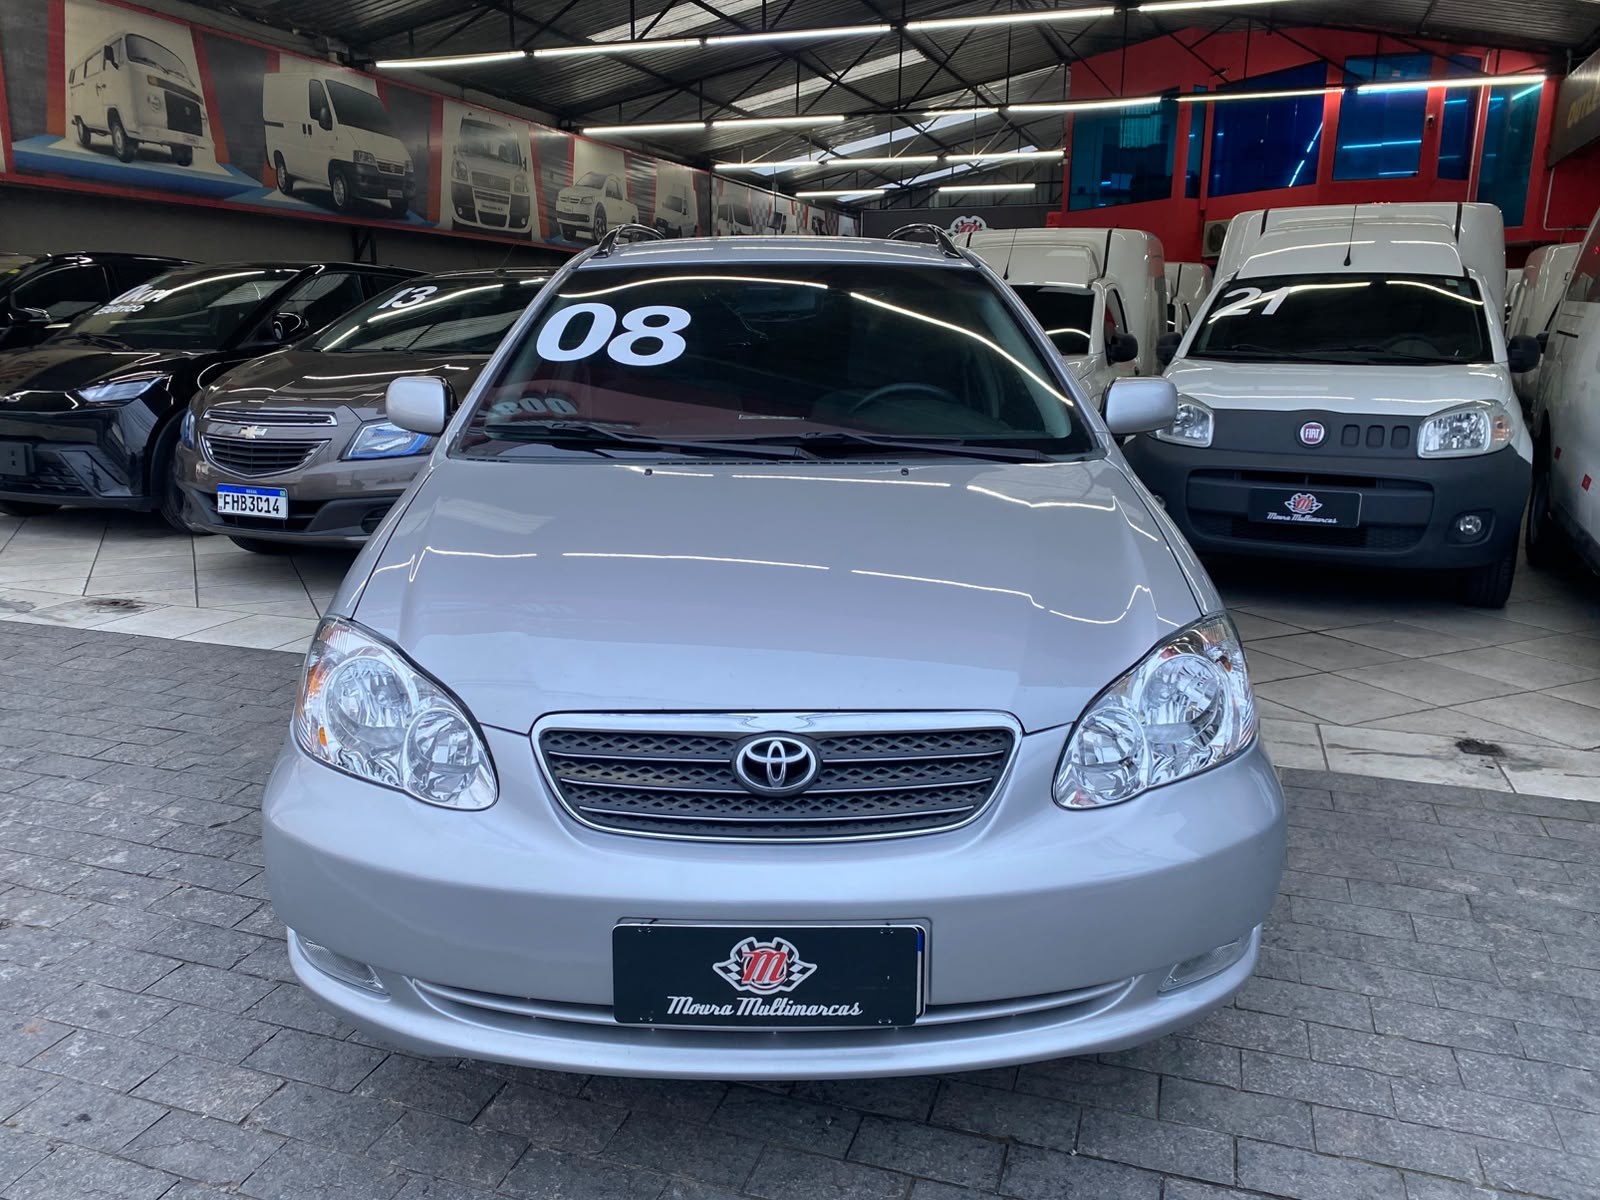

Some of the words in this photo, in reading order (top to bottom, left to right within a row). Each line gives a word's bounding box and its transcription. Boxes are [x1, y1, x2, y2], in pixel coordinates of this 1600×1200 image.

[377, 286, 438, 309] 13
[1209, 287, 1292, 316] 21
[536, 303, 692, 366] 08
[1305, 428, 1320, 439] FIAT
[223, 494, 279, 514] FHB3C14
[1266, 512, 1291, 521] Moura
[667, 996, 735, 1016] Moura
[736, 997, 863, 1017] Multimarcas
